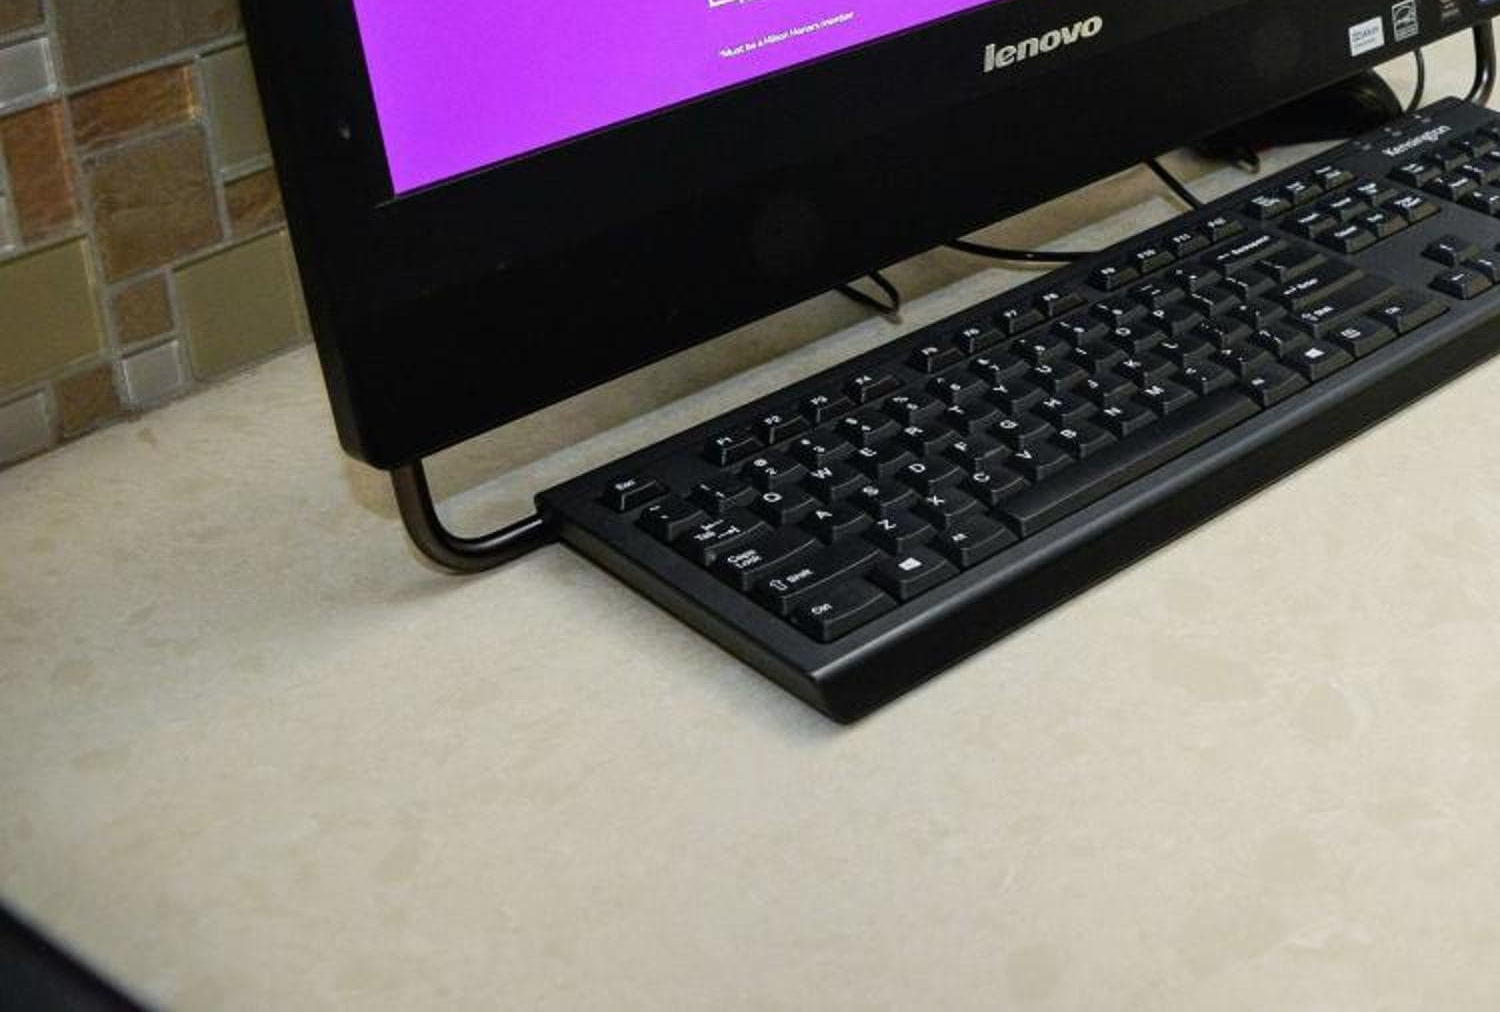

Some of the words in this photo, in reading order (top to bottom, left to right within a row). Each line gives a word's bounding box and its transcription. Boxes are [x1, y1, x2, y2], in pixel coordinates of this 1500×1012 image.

[984, 15, 1103, 73] lenovo
[859, 447, 877, 457] E
[1015, 449, 1033, 459] V
[908, 463, 926, 473] D
[972, 472, 991, 483] C
[926, 495, 945, 506] X
[877, 518, 897, 531] Z
